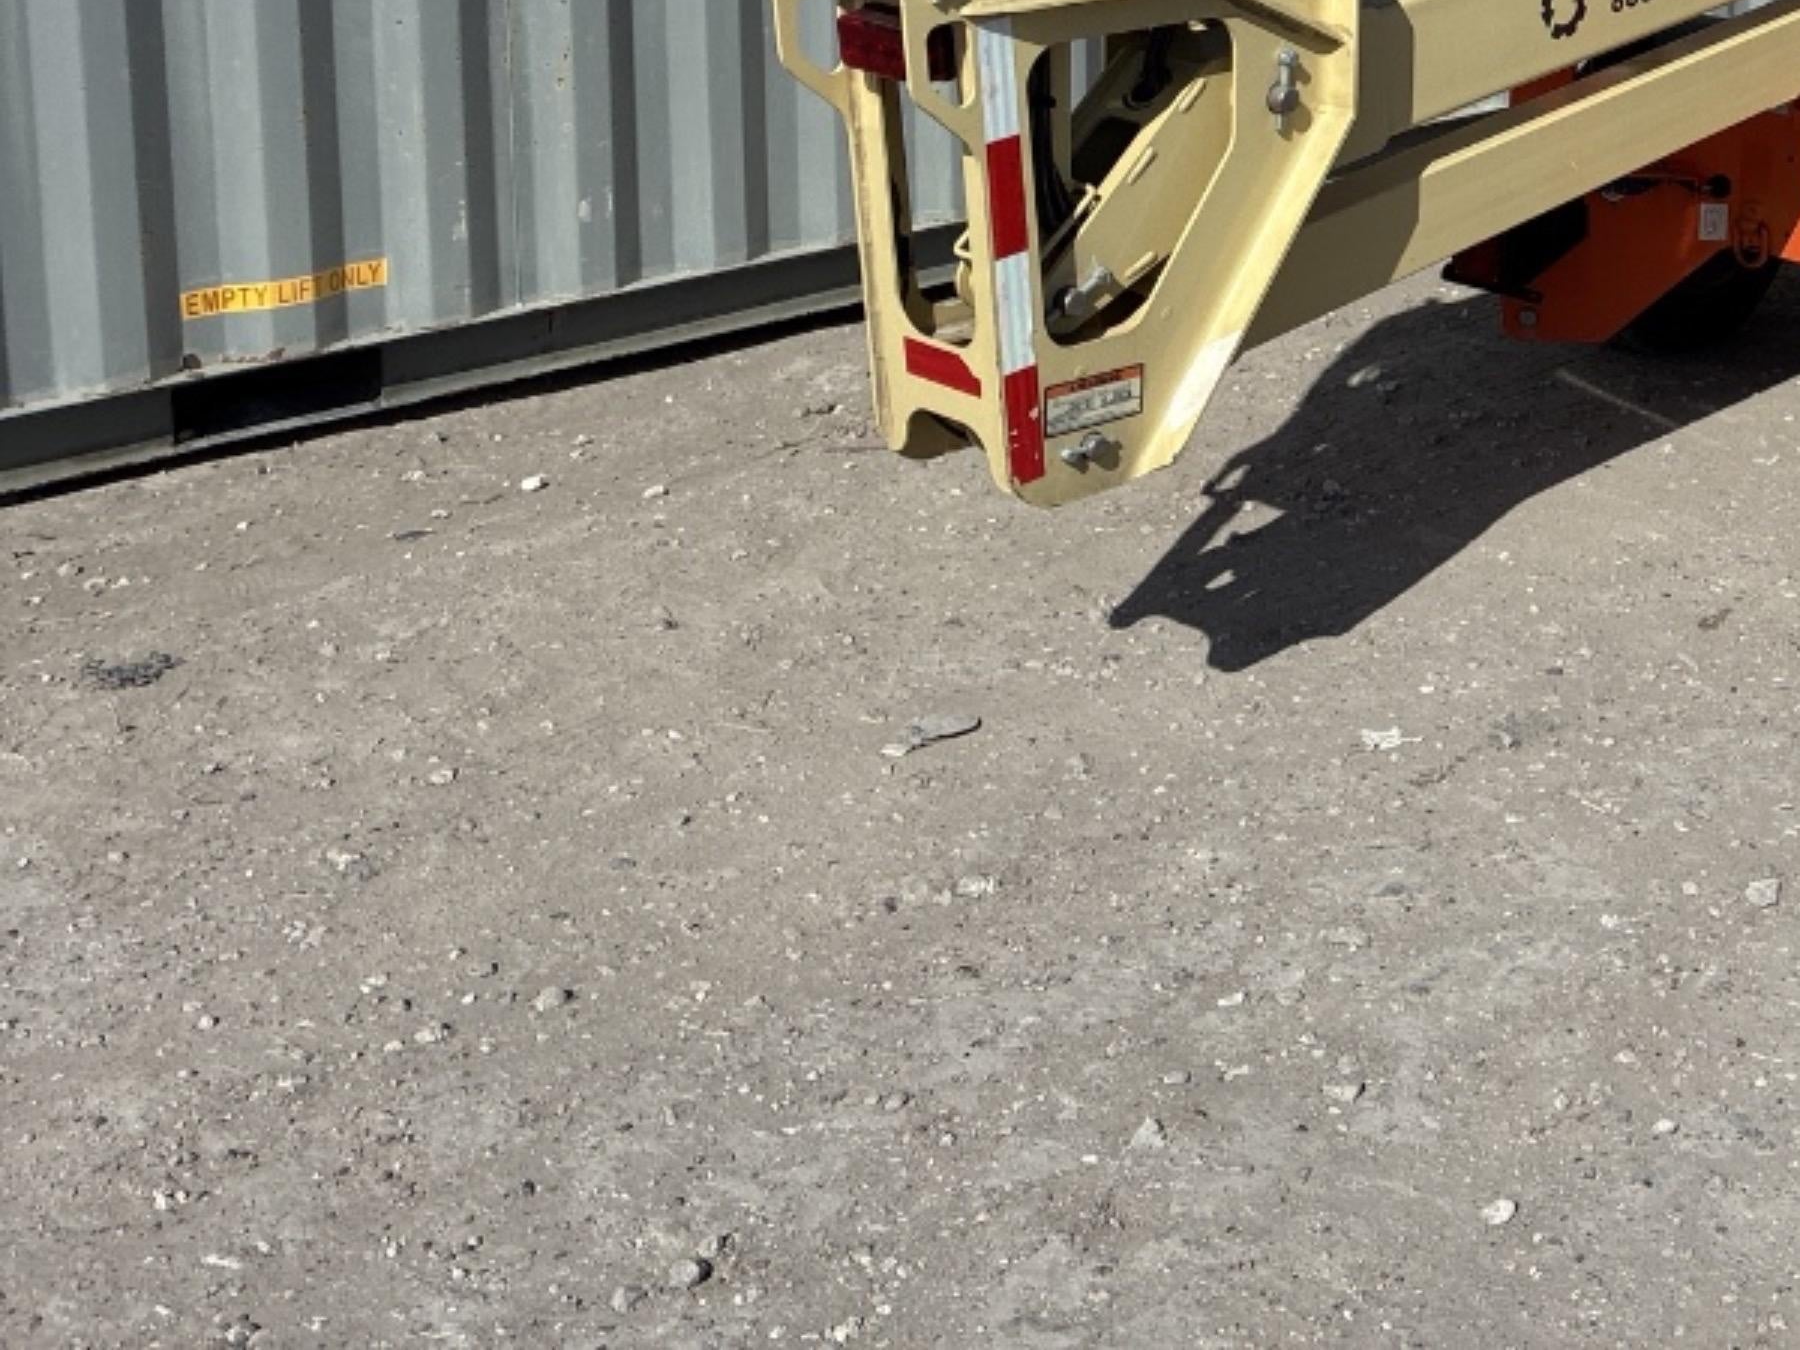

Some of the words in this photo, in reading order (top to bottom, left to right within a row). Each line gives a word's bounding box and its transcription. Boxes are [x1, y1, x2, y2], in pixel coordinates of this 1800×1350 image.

[184, 286, 269, 317] EMPTY
[277, 271, 322, 304] LIFT
[329, 261, 382, 289] ONLY
